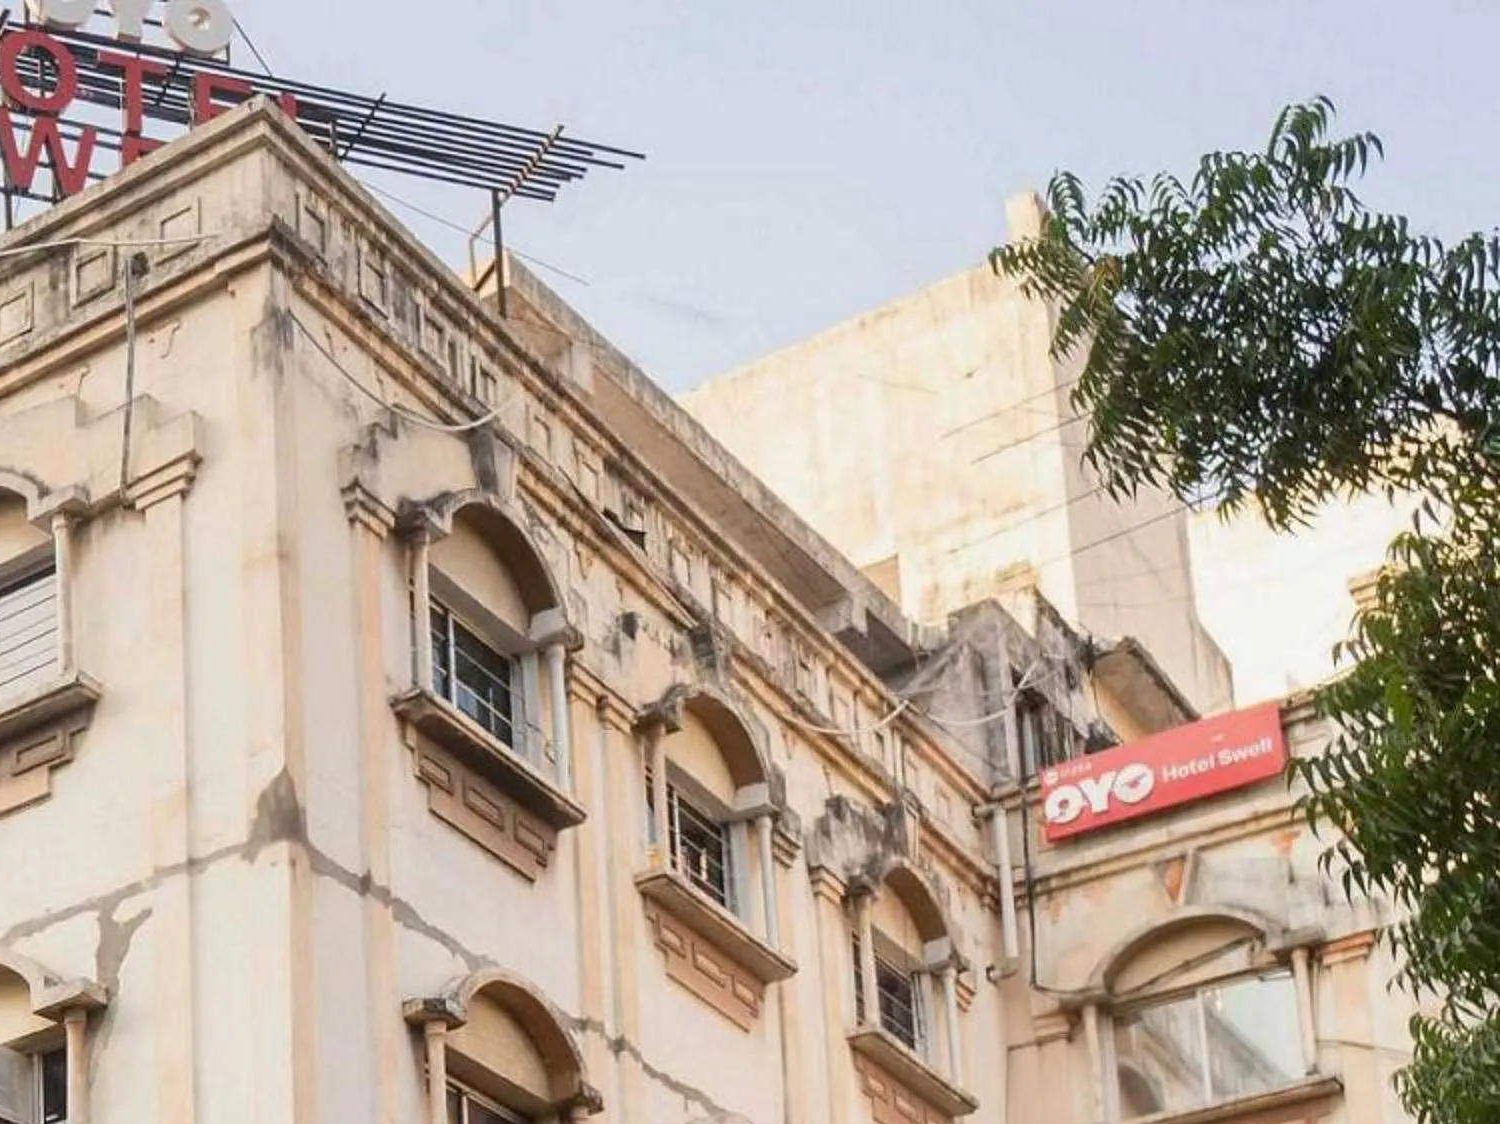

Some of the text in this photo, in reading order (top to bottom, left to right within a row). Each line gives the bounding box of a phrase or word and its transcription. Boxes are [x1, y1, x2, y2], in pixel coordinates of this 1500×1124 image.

[1044, 762, 1154, 824] OYO
[1162, 755, 1215, 784] Hotel
[1218, 736, 1273, 767] Swell
